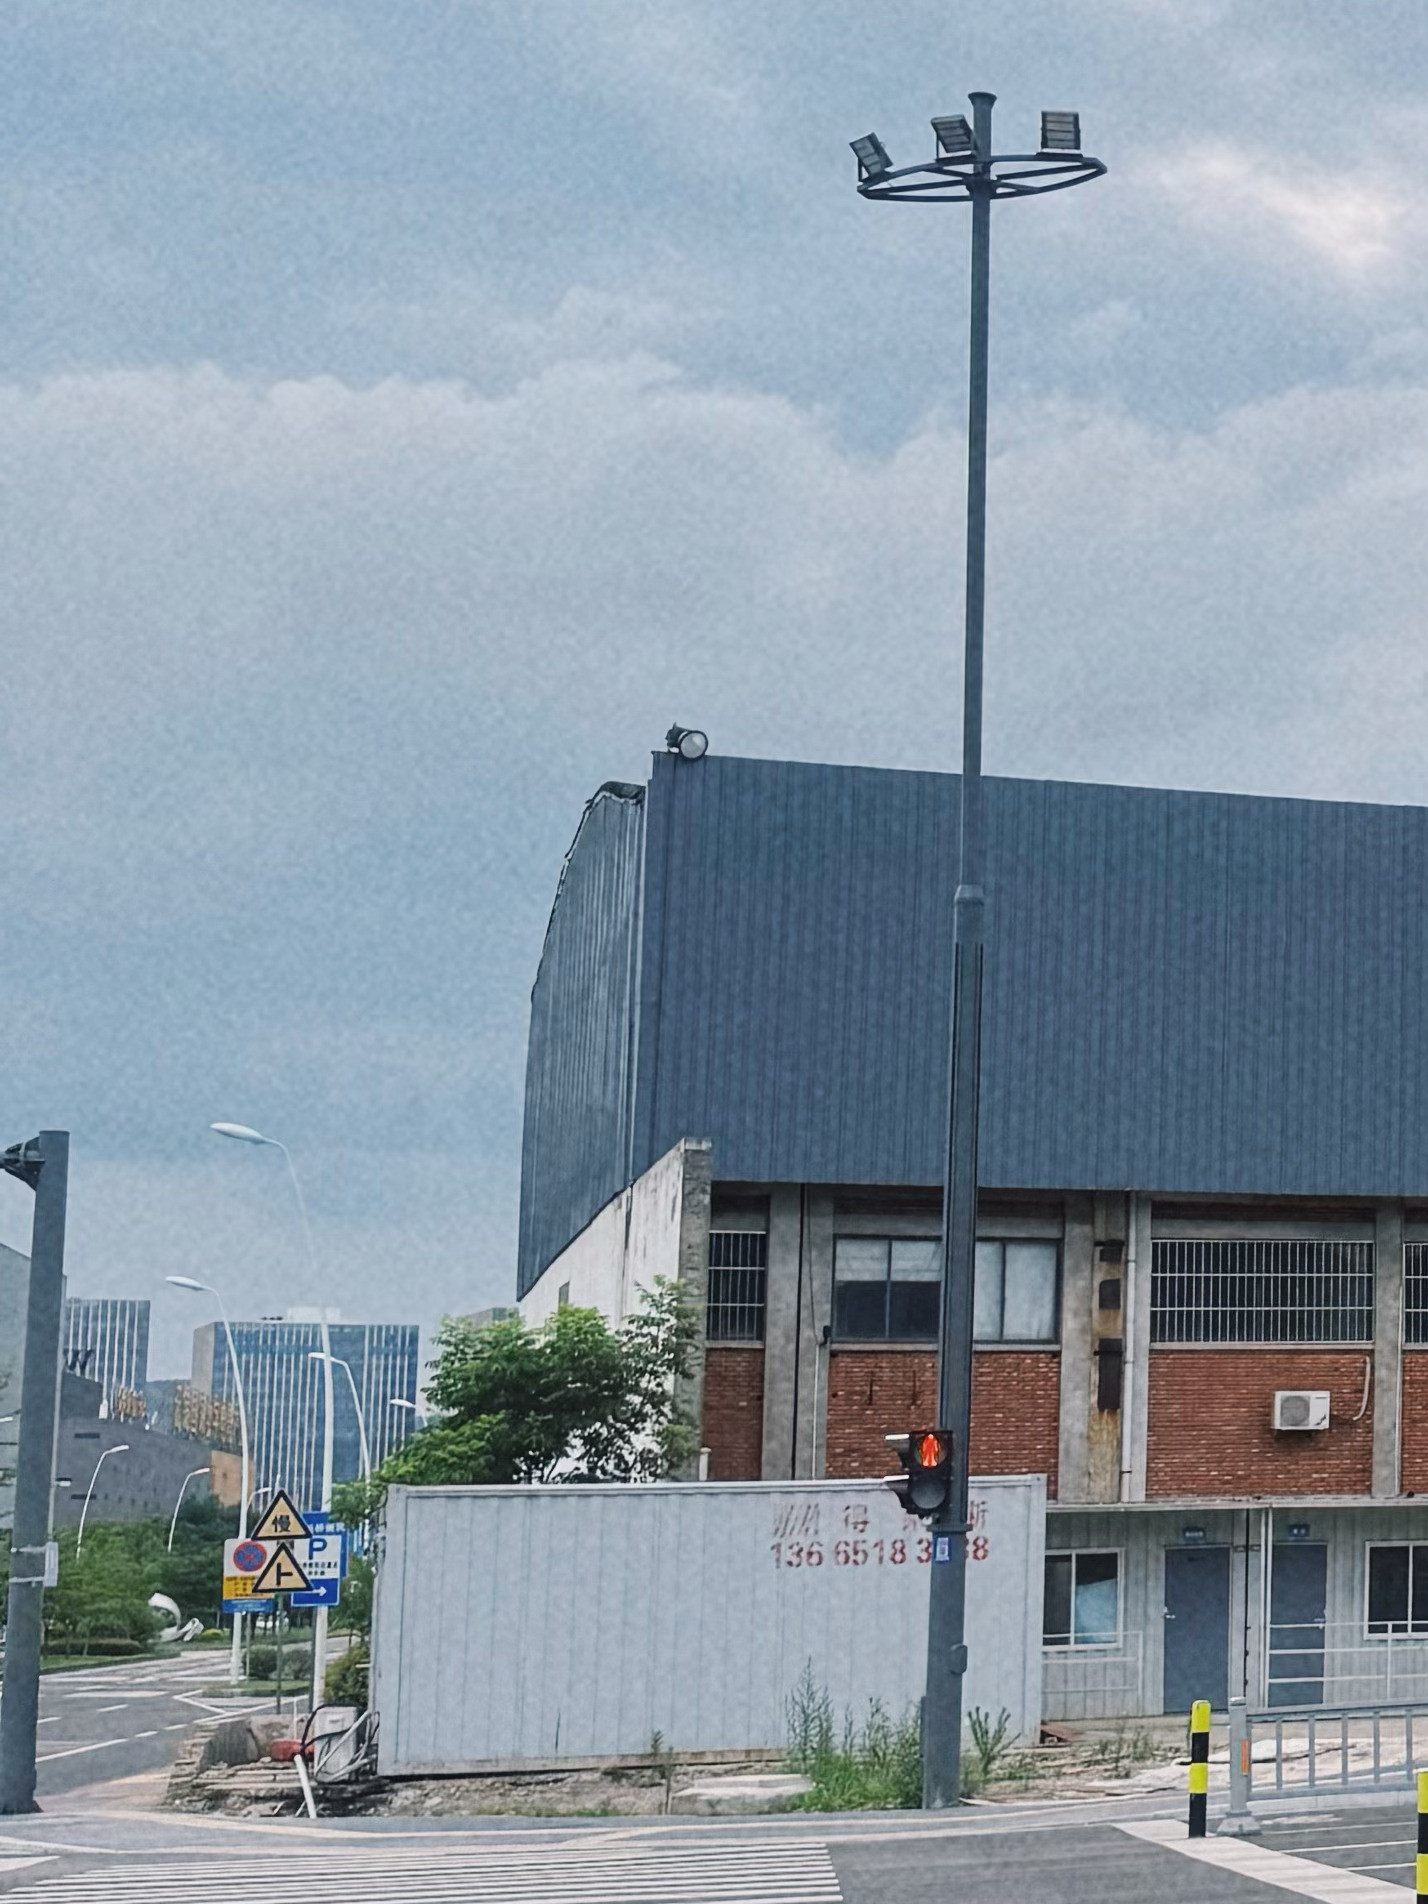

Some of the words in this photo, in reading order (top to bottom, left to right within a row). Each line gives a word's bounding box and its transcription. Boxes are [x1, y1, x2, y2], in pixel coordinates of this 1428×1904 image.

[272, 1514, 291, 1533] 慢
[308, 1538, 327, 1560] P
[917, 1536, 989, 1564] 38
